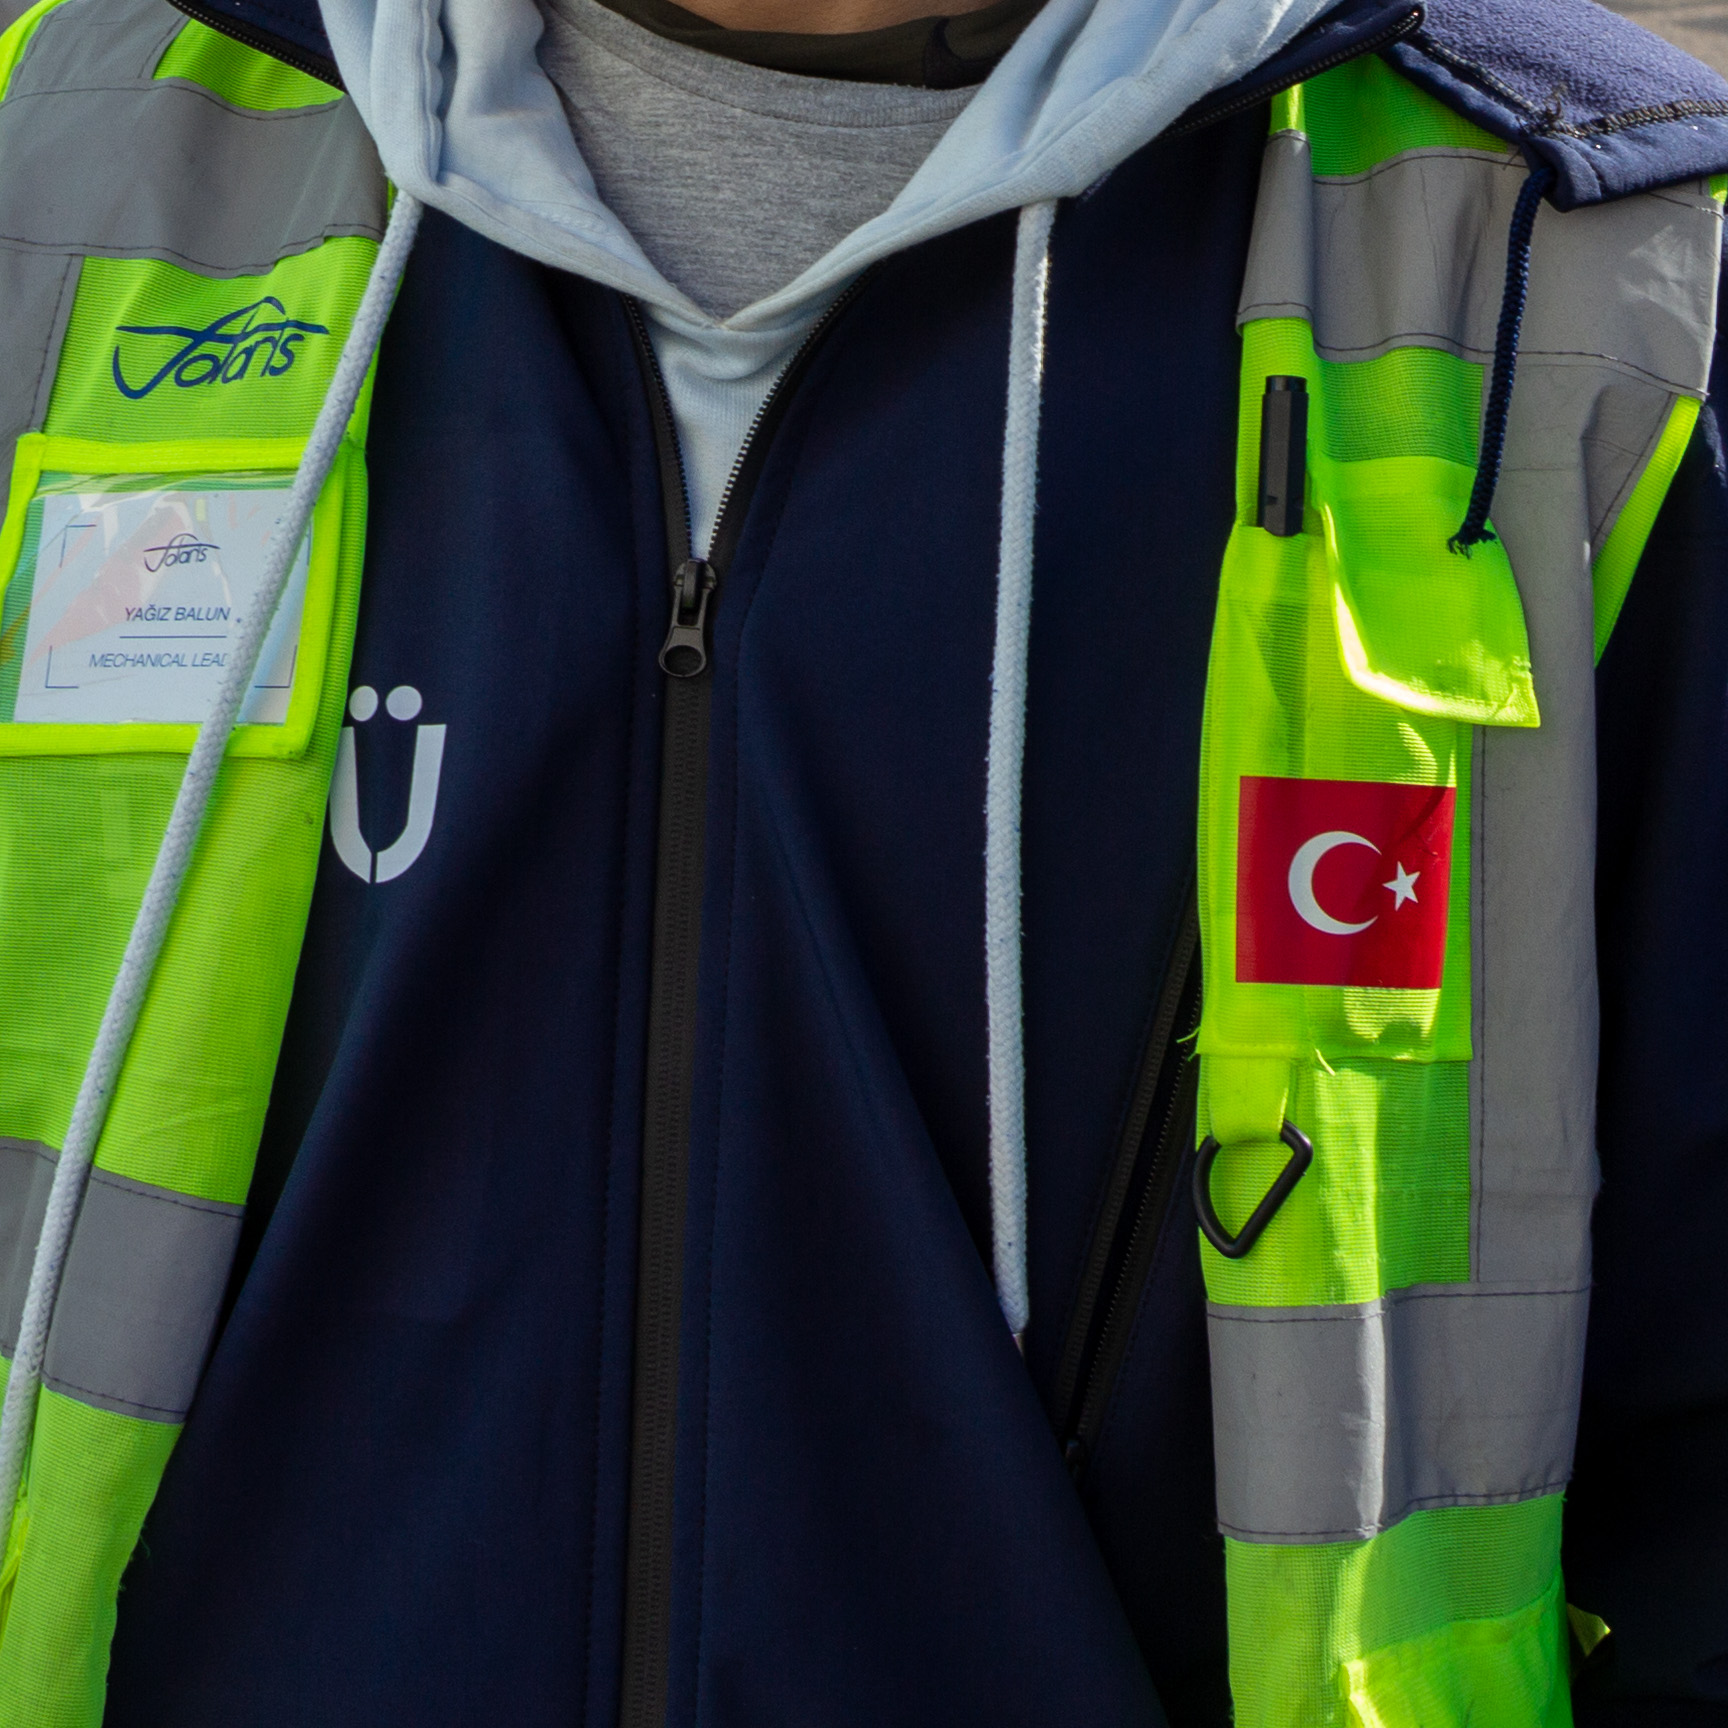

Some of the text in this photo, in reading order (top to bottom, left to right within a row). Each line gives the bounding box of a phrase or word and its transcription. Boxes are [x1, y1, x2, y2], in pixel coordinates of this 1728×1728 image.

[124, 604, 232, 622] YAĞIZ BALUN
[88, 652, 189, 668] MECHANICAL
